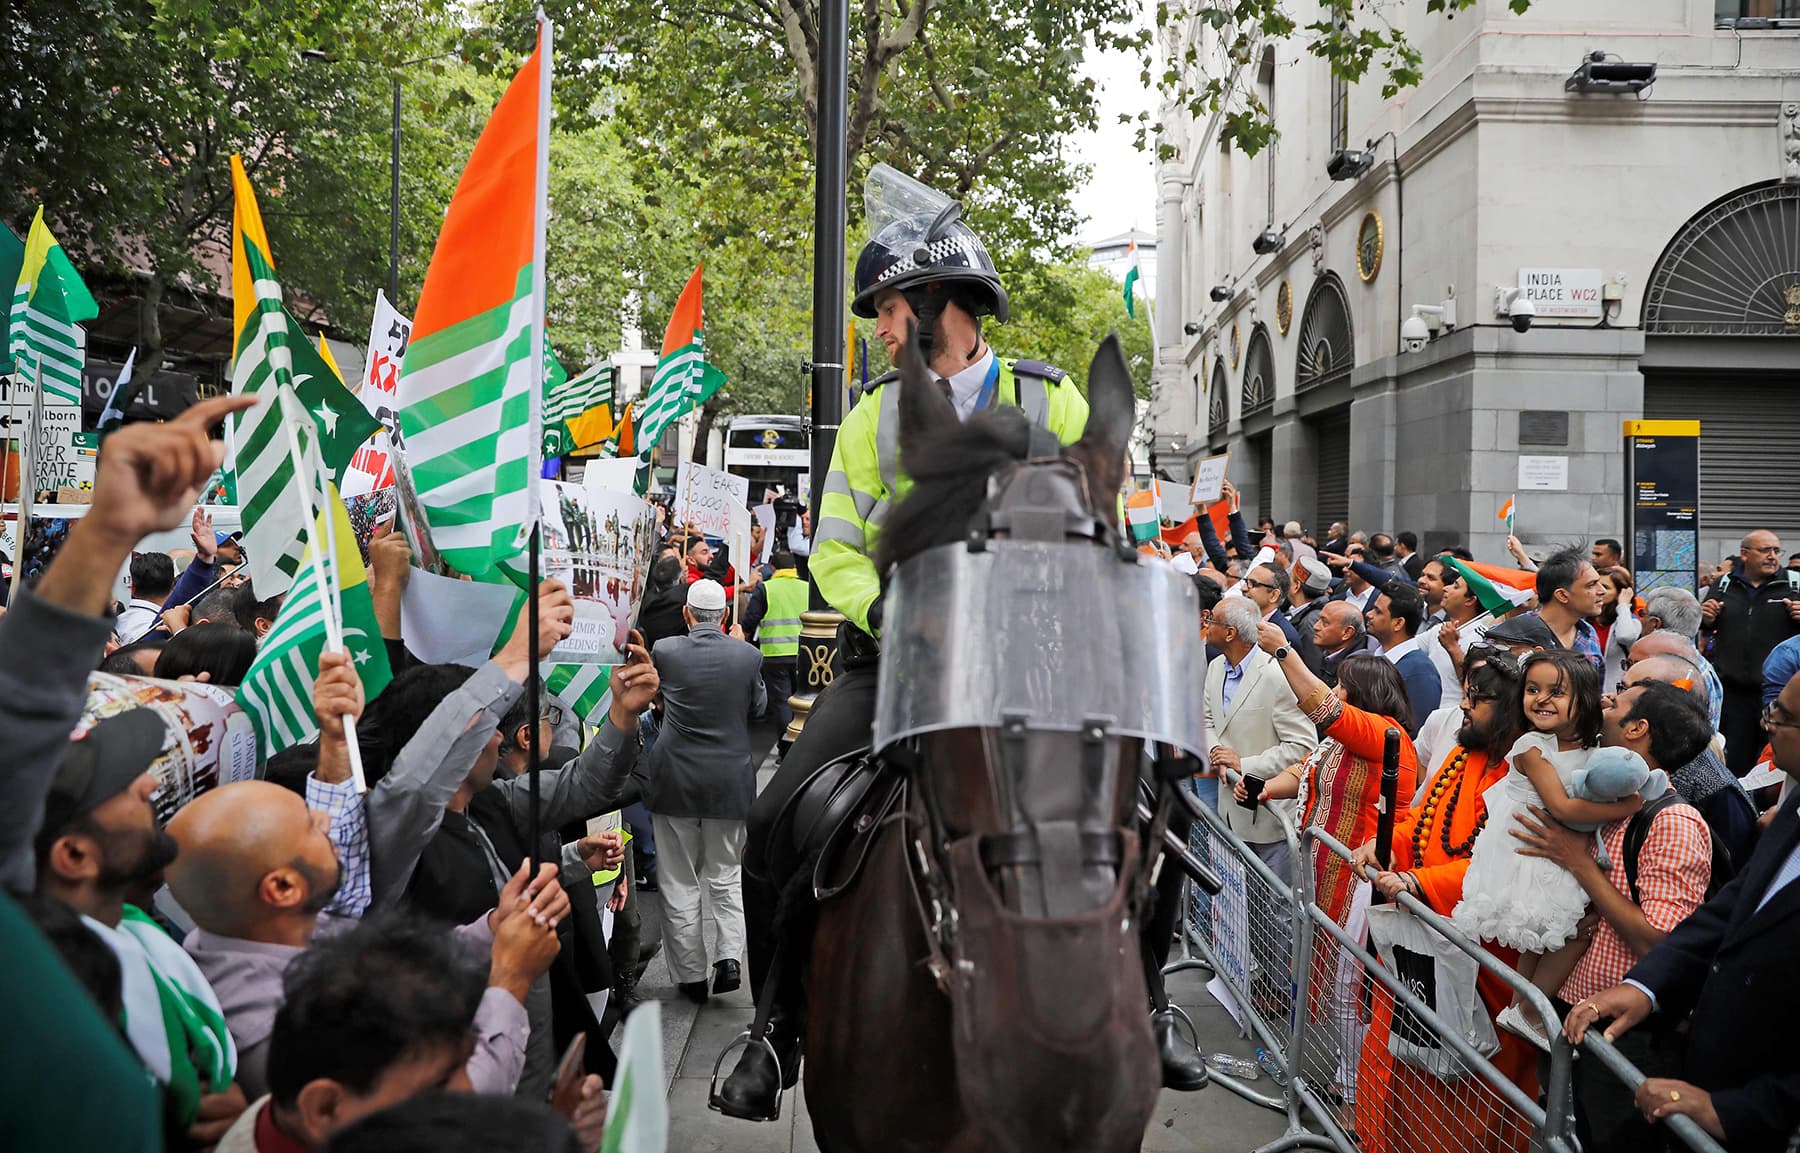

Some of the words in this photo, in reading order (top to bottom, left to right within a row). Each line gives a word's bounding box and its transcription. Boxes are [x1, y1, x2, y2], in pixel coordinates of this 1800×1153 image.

[1527, 273, 1562, 286] INDIA
[1527, 288, 1563, 301] PLACE
[1571, 288, 1597, 301] WC2
[710, 471, 740, 497] YEARS
[597, 623, 607, 635] IS
